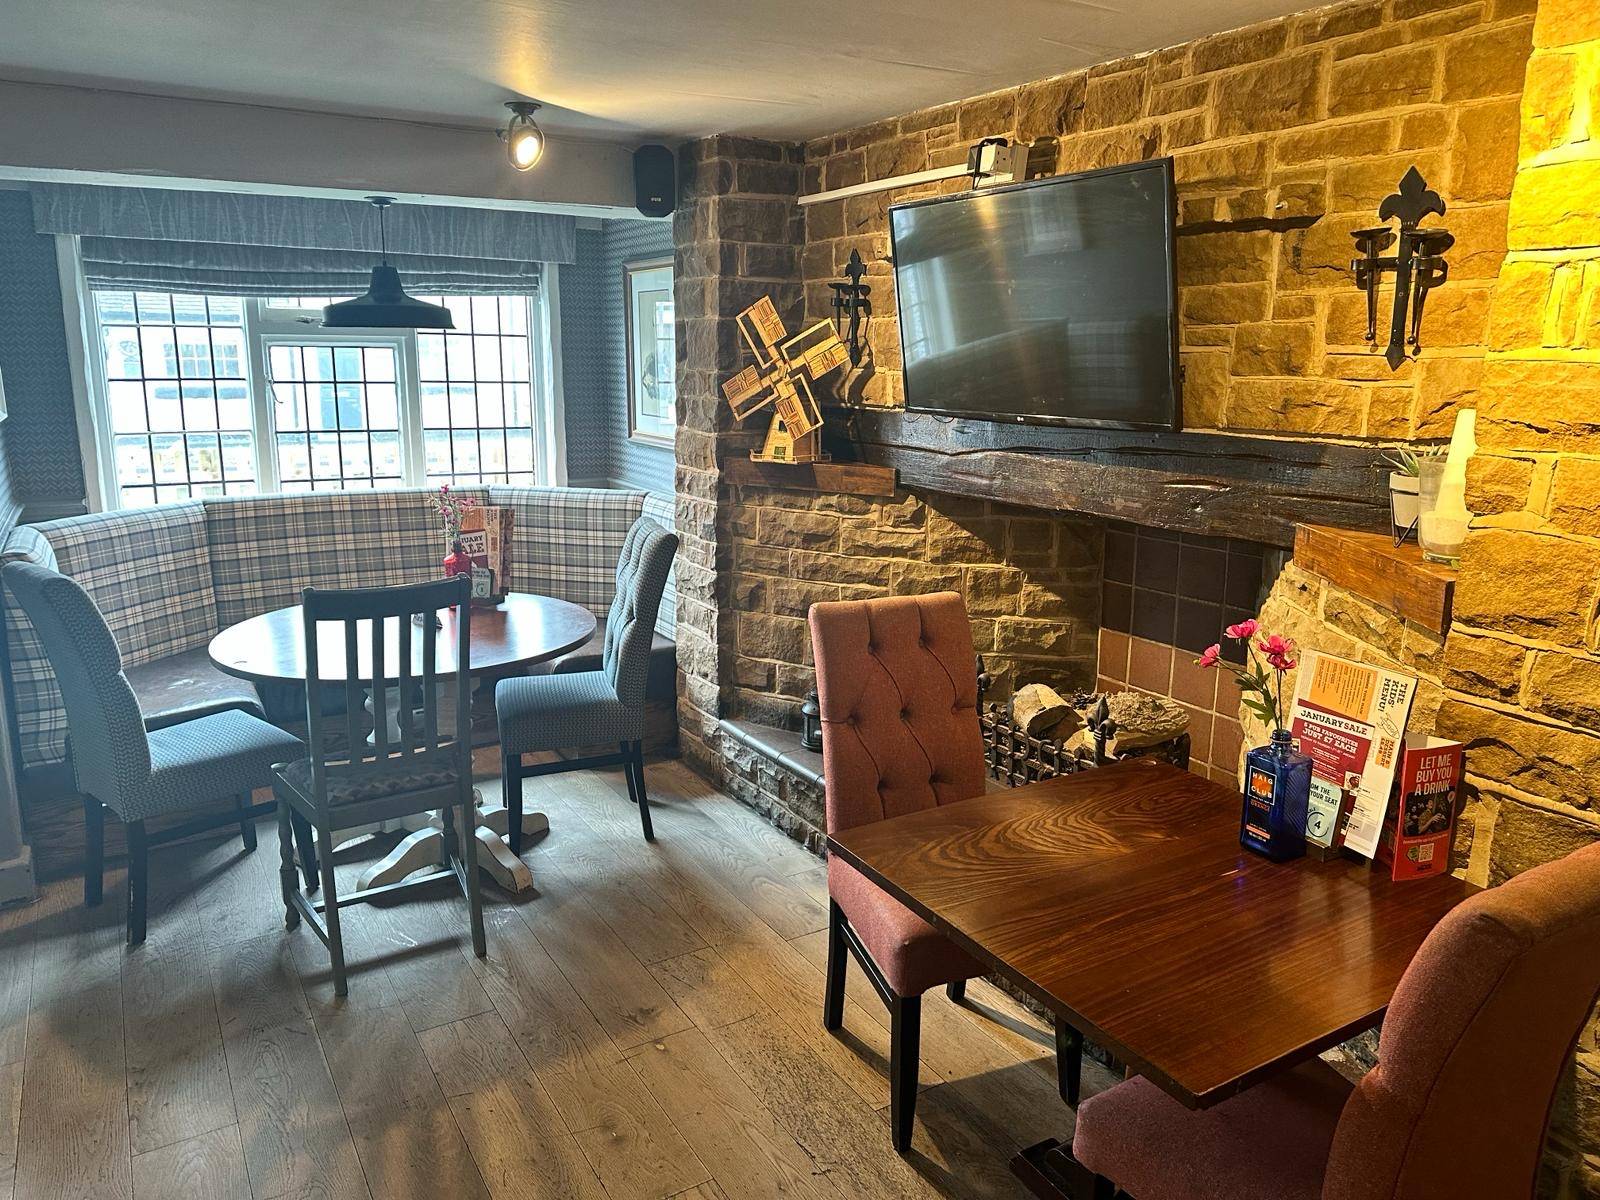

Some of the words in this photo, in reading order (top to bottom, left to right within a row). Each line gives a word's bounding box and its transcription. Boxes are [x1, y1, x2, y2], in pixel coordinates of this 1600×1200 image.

[1378, 678, 1391, 712] MENU!
[1397, 683, 1408, 705] THE
[1301, 710, 1344, 728] JANUARY
[1344, 722, 1368, 735] SALE
[1303, 728, 1322, 740] JUST
[1323, 736, 1333, 744] £7
[1334, 740, 1357, 754] EACH
[1309, 723, 1321, 733] PUB
[1321, 728, 1359, 747] FAVOURITES
[1420, 756, 1437, 770] LET
[1437, 753, 1453, 768] ME
[1252, 772, 1273, 785] HAIG
[1416, 768, 1436, 783] BUY
[1436, 766, 1453, 781] YOU
[1251, 785, 1273, 798] CLUB
[1310, 783, 1319, 791] OM
[1320, 786, 1331, 796] THE
[1414, 784, 1421, 796] A
[1423, 779, 1451, 796] DRINK
[1310, 790, 1323, 801] YOUR
[1324, 795, 1338, 806] SEAT
[1314, 820, 1321, 830] 4
